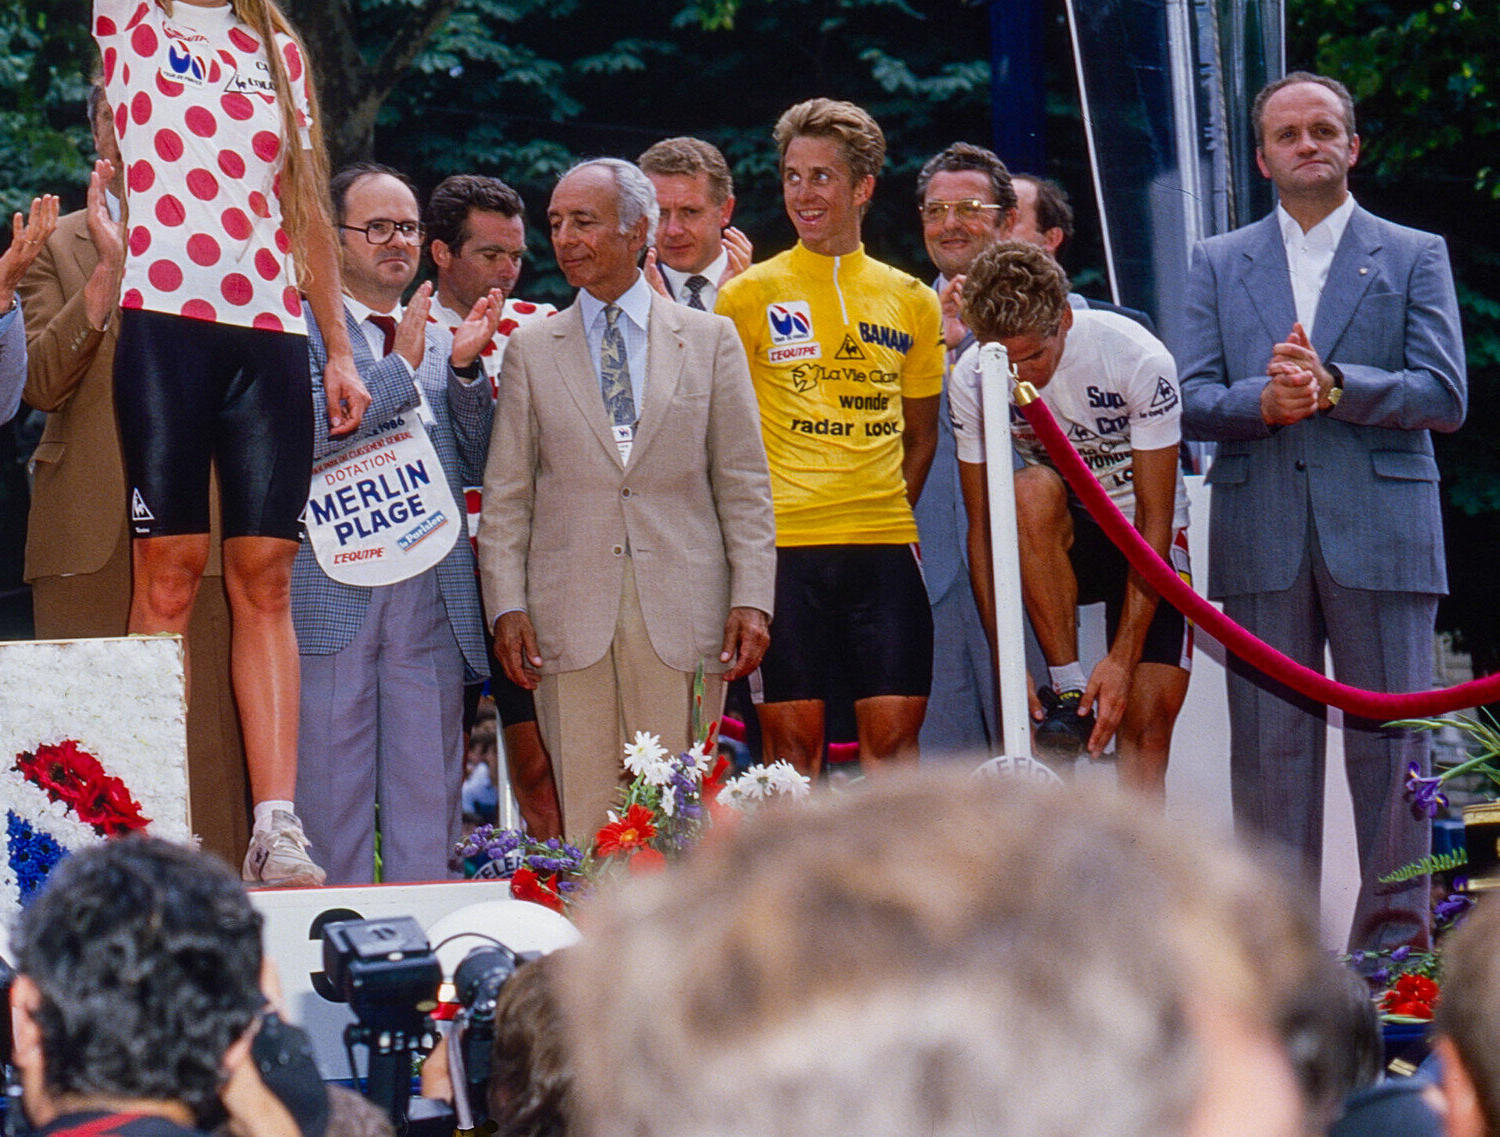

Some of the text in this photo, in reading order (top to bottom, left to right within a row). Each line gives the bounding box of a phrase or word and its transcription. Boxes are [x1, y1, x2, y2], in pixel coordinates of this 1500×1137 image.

[771, 345, 818, 362] L'EQUIPE
[820, 366, 841, 381] La
[842, 367, 866, 383] Vie
[378, 416, 405, 433] 1986
[791, 419, 854, 436] radar
[324, 449, 397, 486] DOTATION
[309, 459, 430, 526] MERLIN
[333, 493, 426, 546] PLAGE
[405, 514, 445, 545] Parisien
[333, 546, 385, 565] L'EQUIPE
